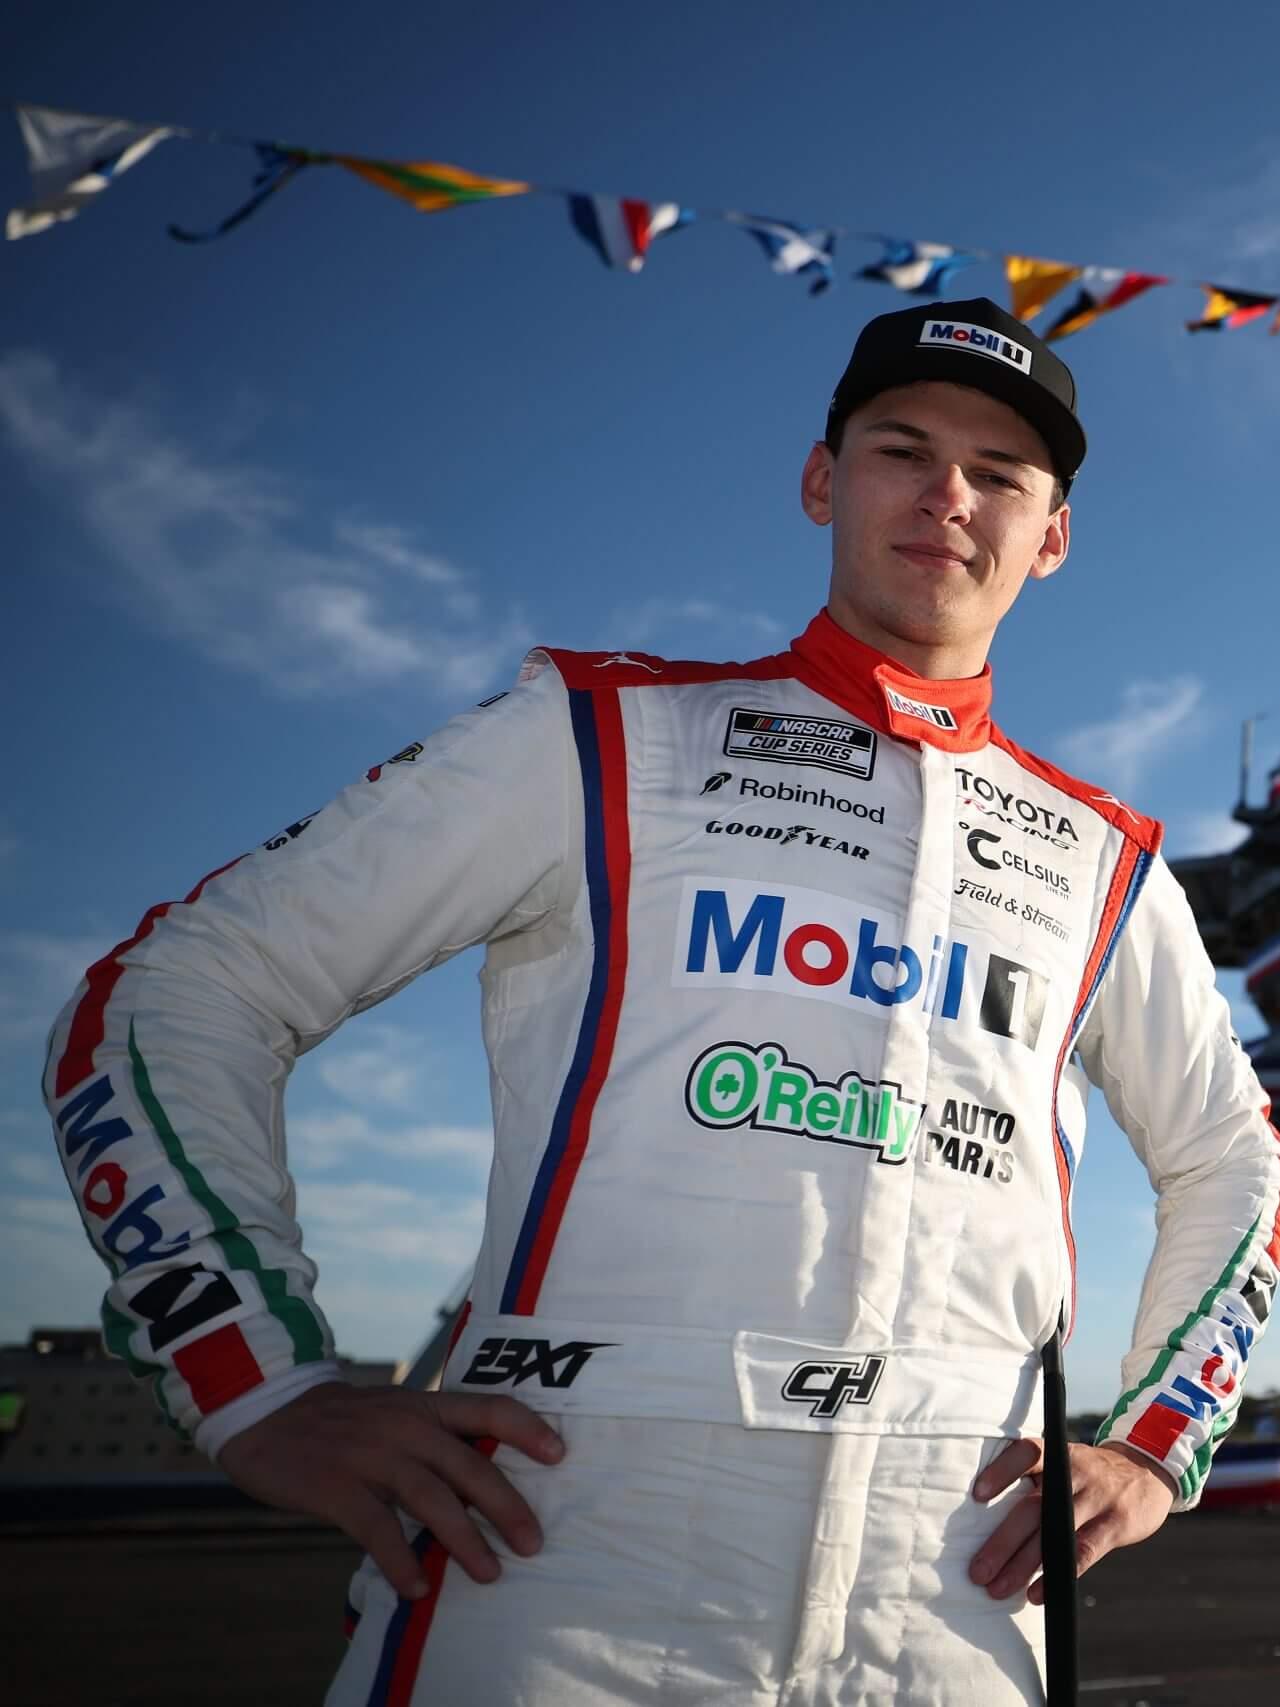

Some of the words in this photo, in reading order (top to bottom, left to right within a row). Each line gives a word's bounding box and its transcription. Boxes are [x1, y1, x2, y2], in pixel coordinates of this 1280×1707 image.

[930, 324, 1000, 352] Mobil
[888, 690, 932, 721] Mobil
[748, 736, 788, 750] CUP
[788, 739, 853, 762] SERIES
[778, 719, 854, 743] NASCAR
[739, 777, 885, 825] Robinhood
[954, 768, 1079, 842] TOYOTA
[1002, 850, 1070, 893] CELSIUS
[954, 878, 1002, 908] Field
[1004, 898, 1018, 915] &
[1021, 904, 1070, 941] Stream
[686, 889, 969, 1021] Mobil
[696, 1050, 916, 1156] O'Reilly
[940, 1098, 1016, 1145] AUTO
[924, 1131, 1014, 1184] PARTS
